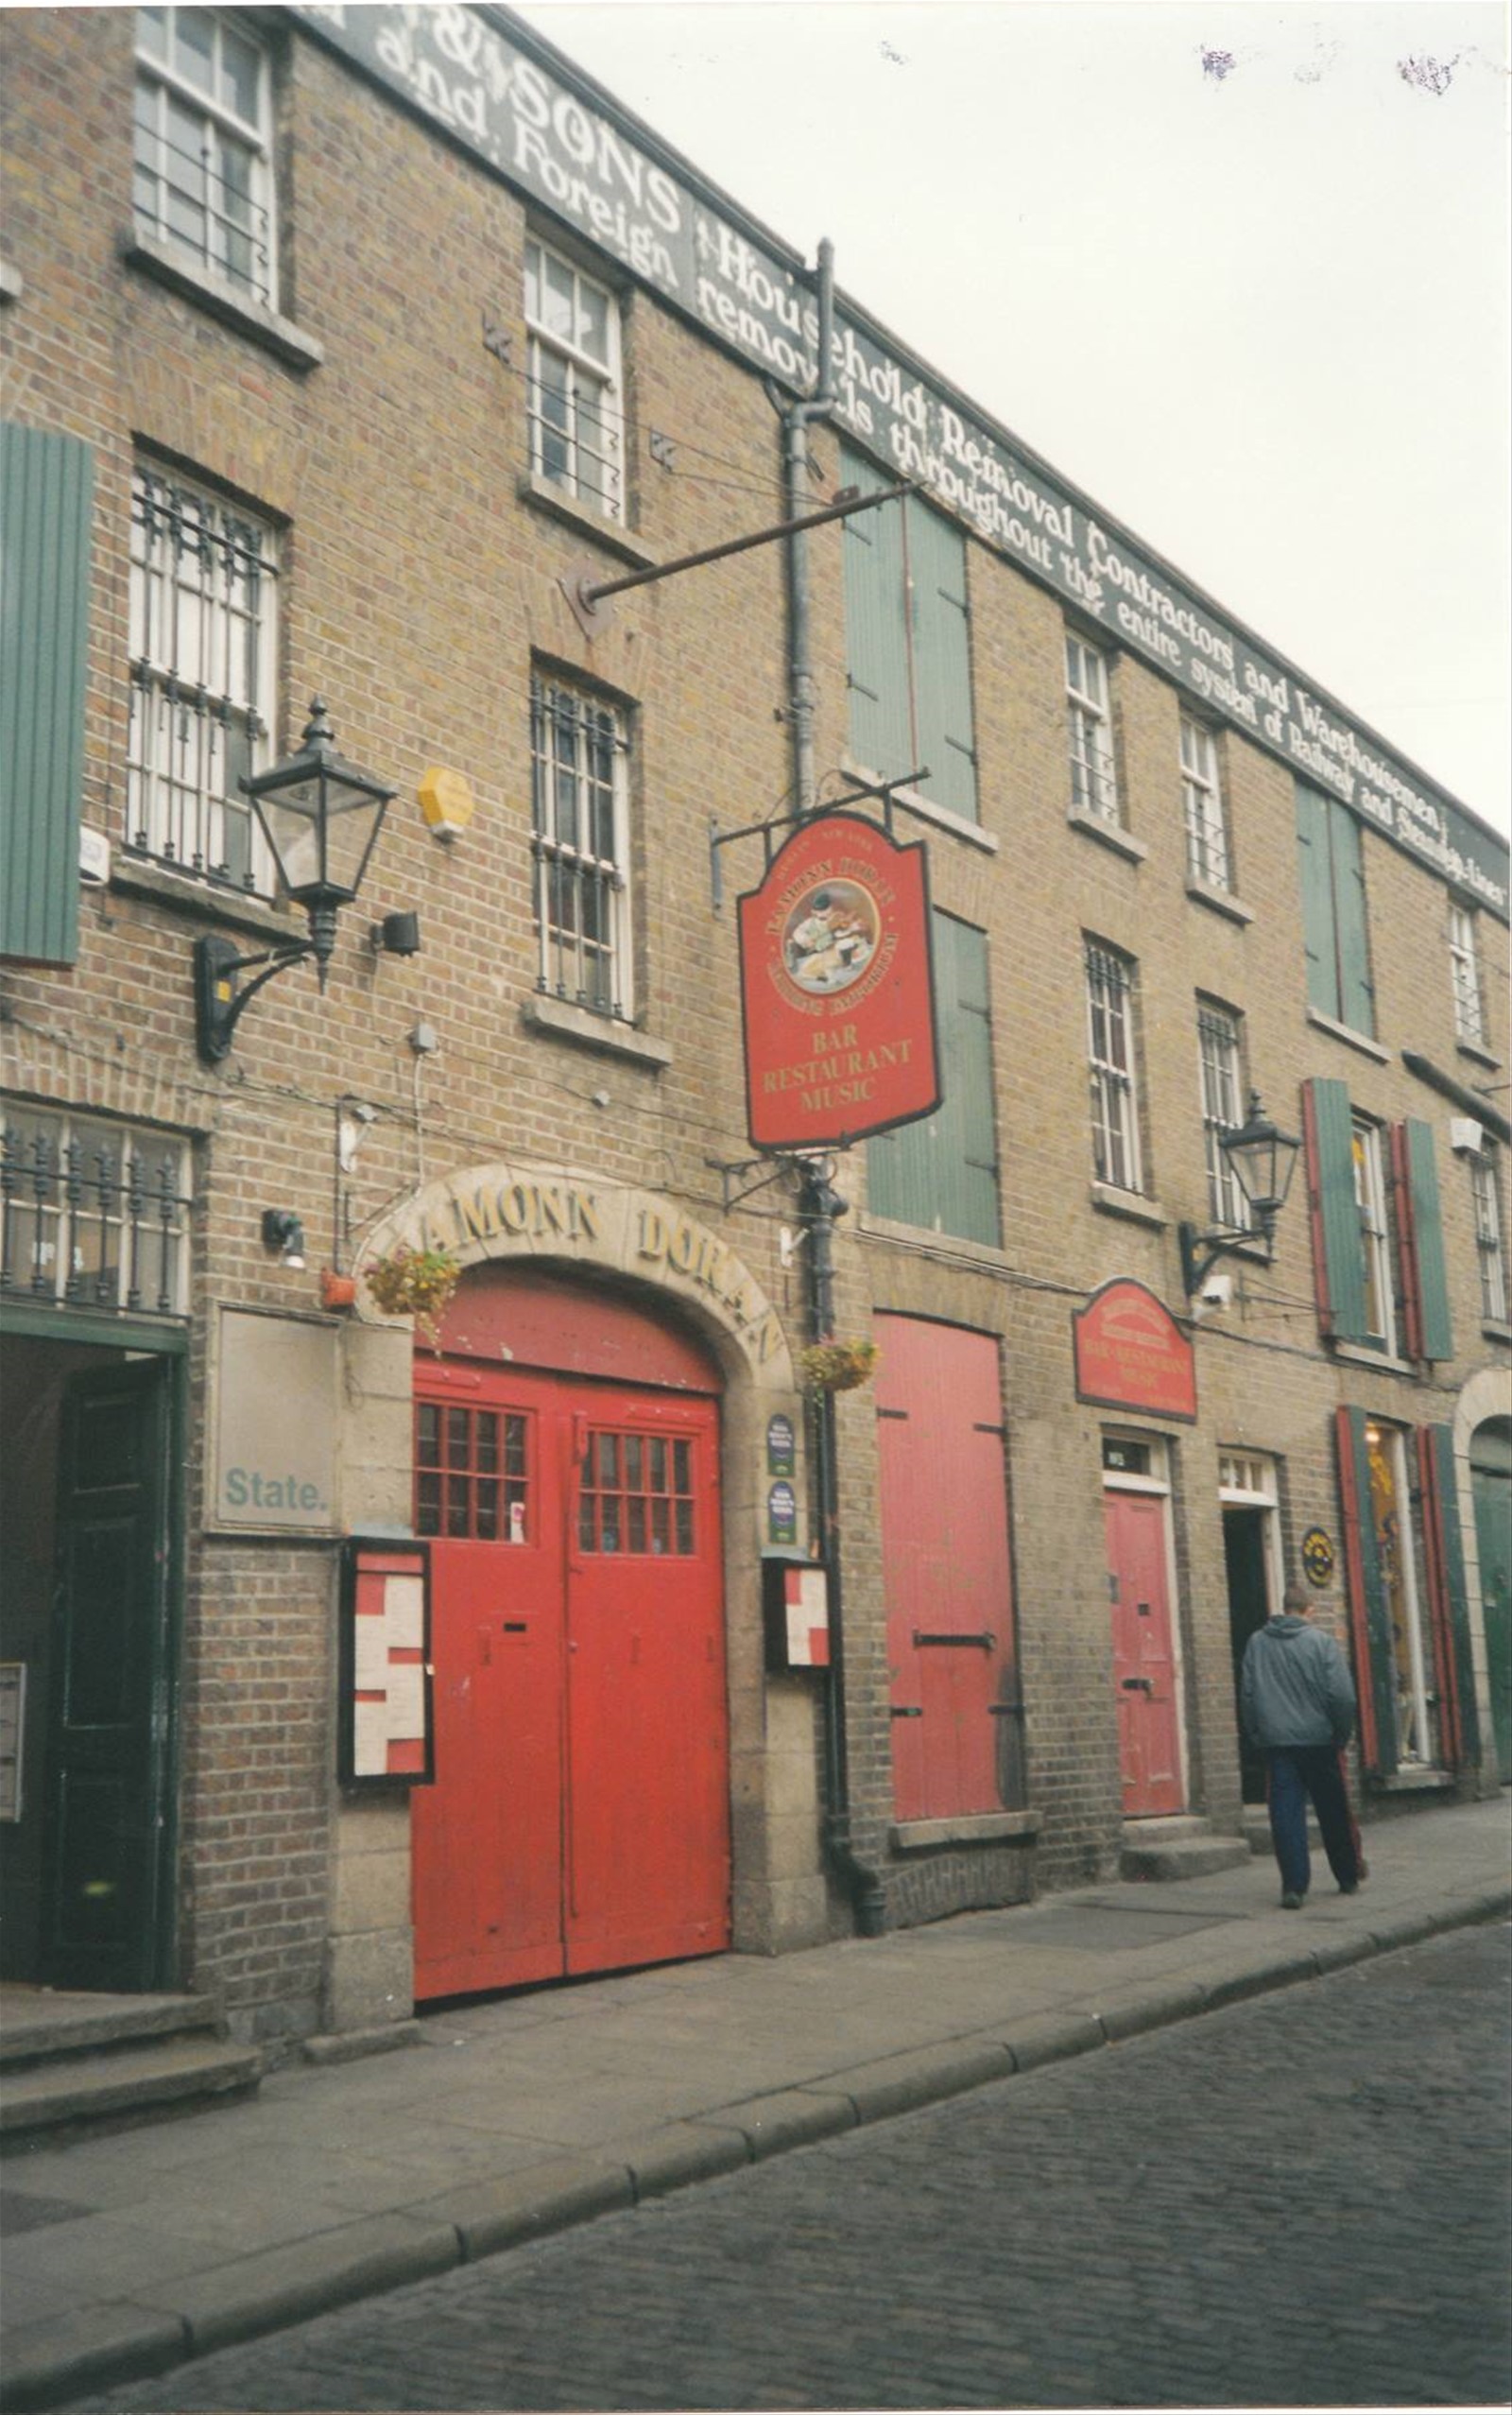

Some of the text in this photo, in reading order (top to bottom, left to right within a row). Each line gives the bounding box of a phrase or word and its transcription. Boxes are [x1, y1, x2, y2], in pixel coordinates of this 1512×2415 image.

[510, 55, 681, 234] SONS
[512, 113, 679, 288] Foreign
[890, 423, 1054, 571] throughout
[1117, 601, 1183, 667] entire
[1263, 710, 1284, 744] of
[940, 405, 1075, 548] Removal
[1088, 521, 1234, 670] Contractors
[1244, 662, 1289, 714] and
[762, 1039, 913, 1094] RESTAURANT
[801, 1077, 877, 1112] MUSIC
[814, 1023, 858, 1055] BAR
[225, 1466, 328, 1511] State.
